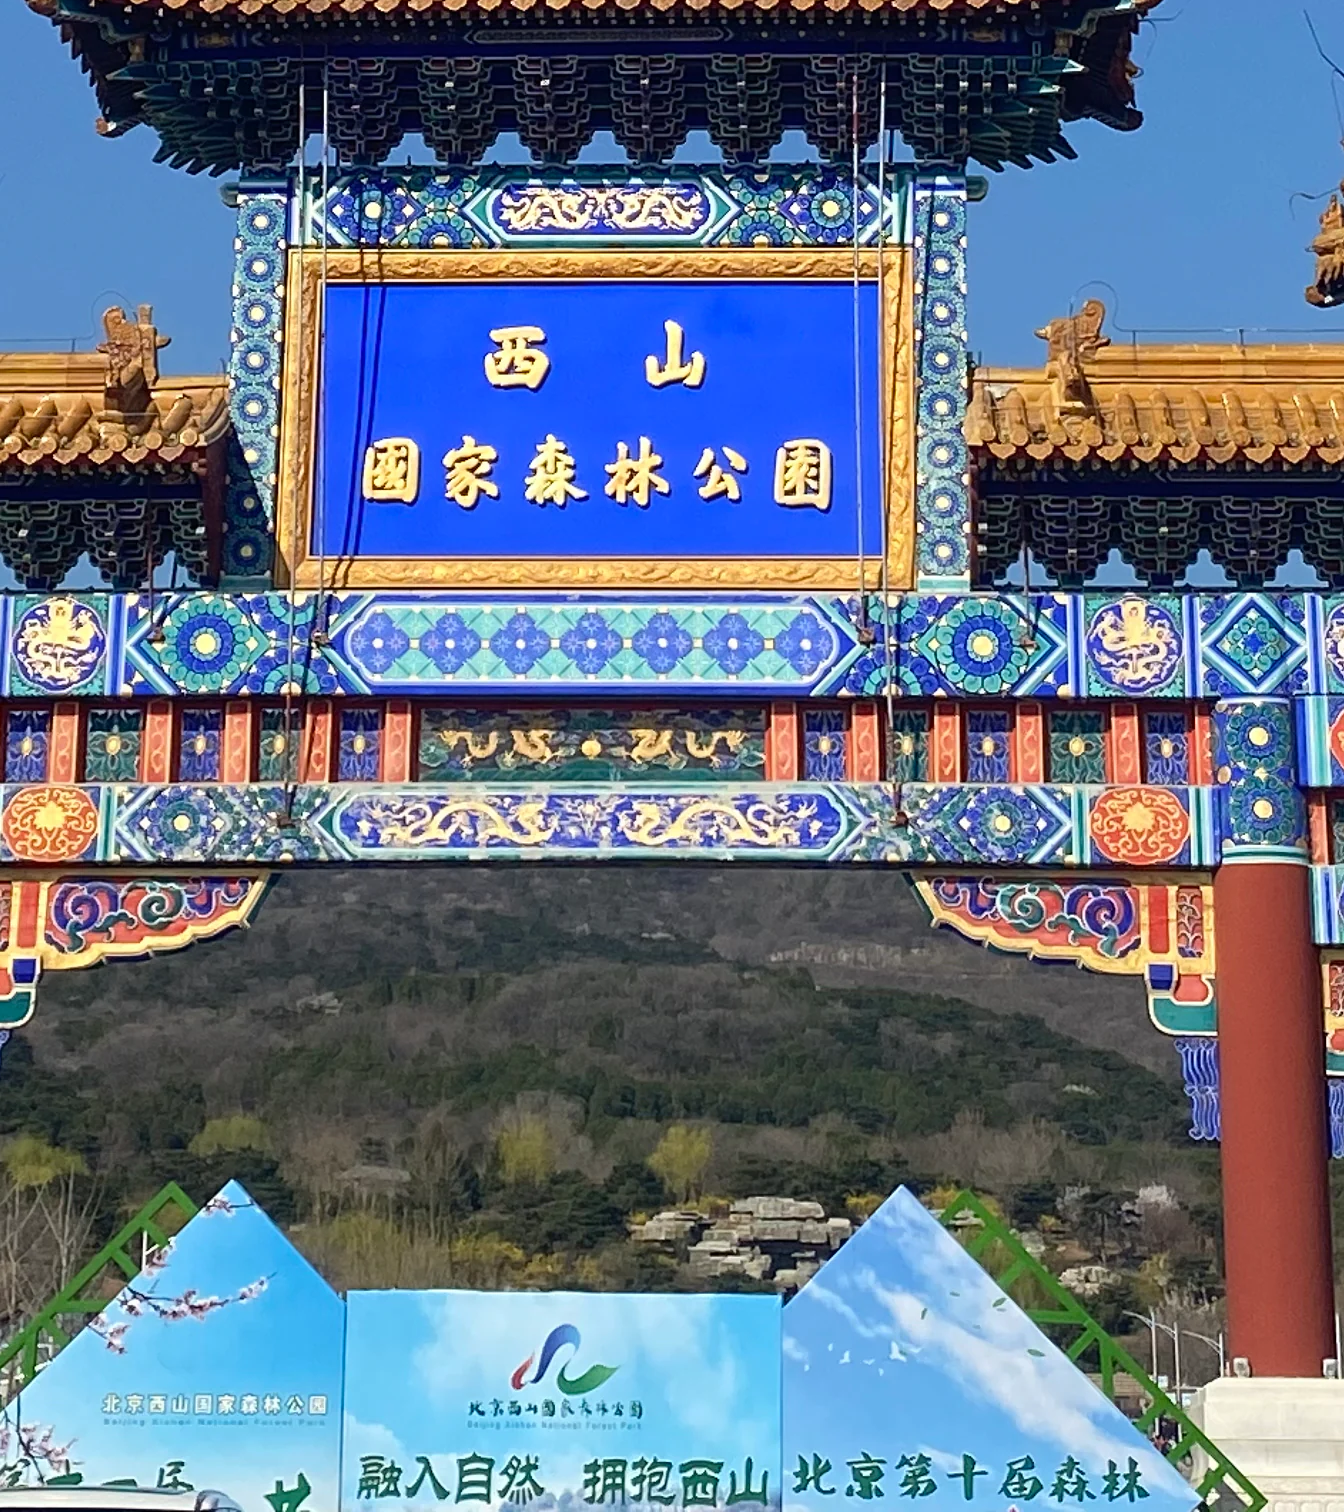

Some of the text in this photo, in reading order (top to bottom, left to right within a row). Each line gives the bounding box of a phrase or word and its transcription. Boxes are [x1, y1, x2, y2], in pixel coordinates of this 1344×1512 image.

[483, 319, 707, 390] 西山
[362, 433, 833, 511] 國家森林公園
[102, 1392, 329, 1416] 北京西山国家森林公园
[355, 1451, 545, 1504] 融入自然
[582, 1456, 769, 1508] 拥抱西山
[792, 1451, 1150, 1503] 北京第十届森林
